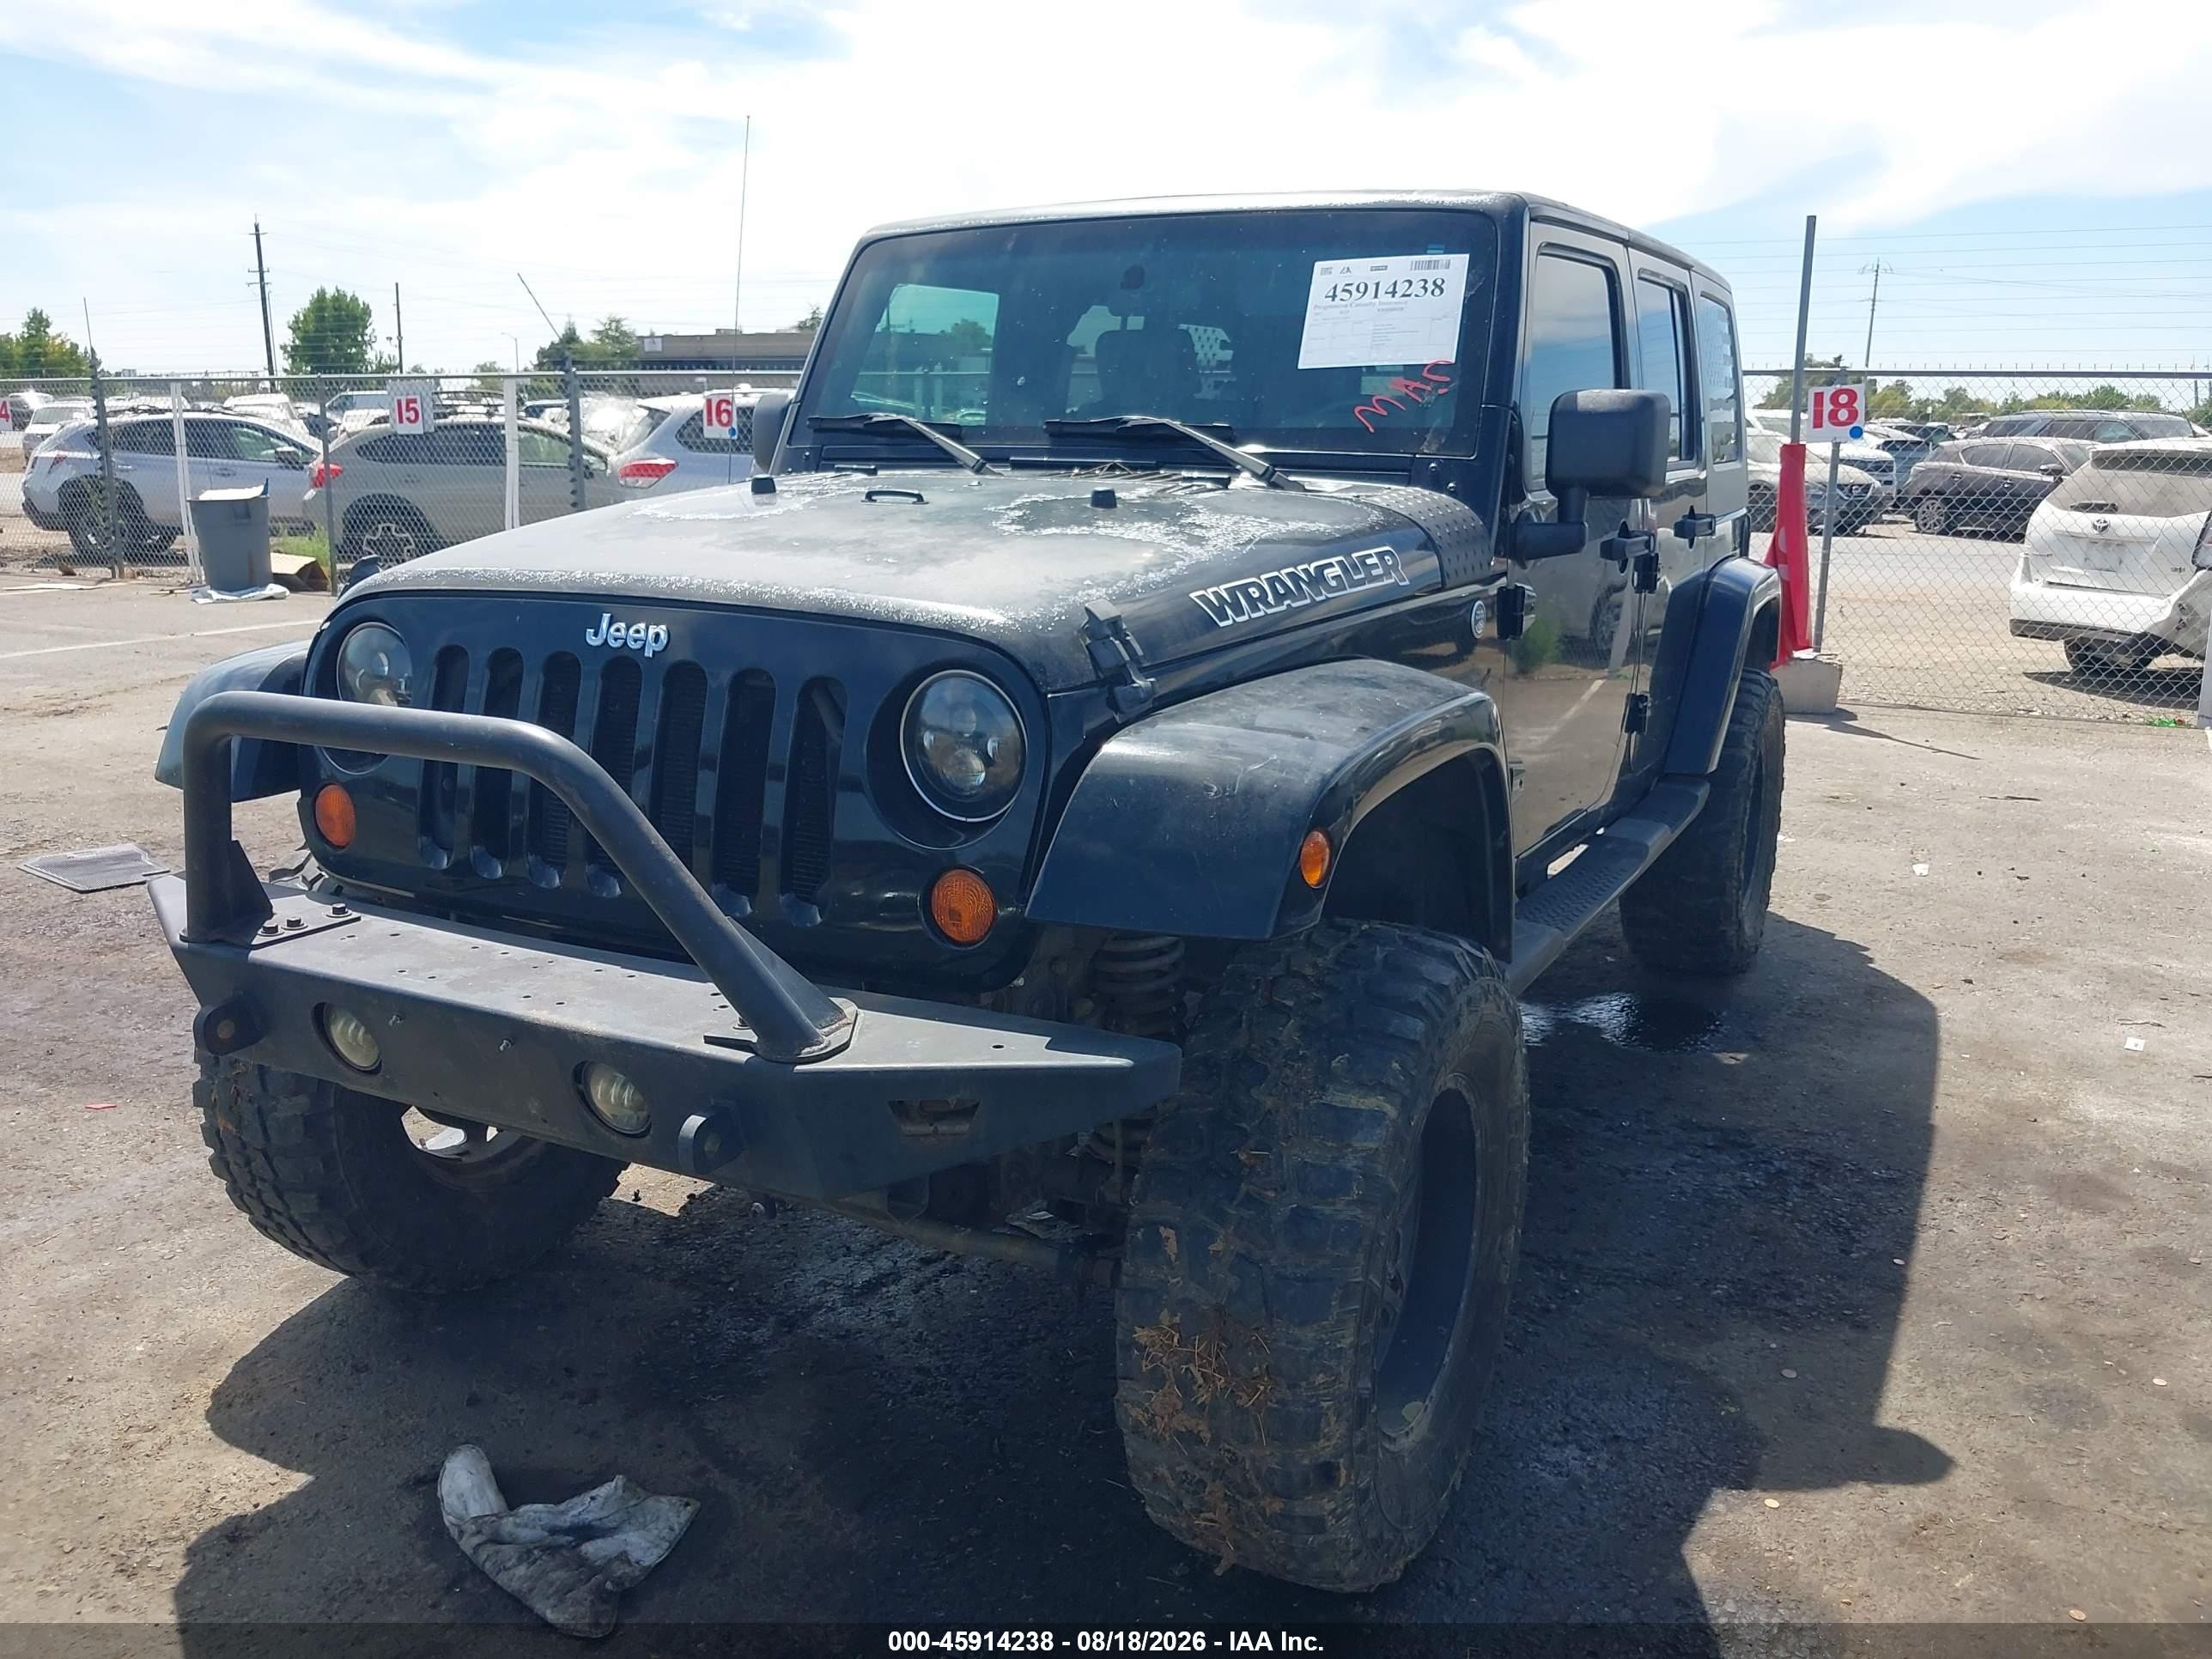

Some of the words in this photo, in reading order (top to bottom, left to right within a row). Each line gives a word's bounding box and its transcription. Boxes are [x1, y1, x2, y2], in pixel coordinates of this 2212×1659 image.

[1325, 277, 1446, 302] 45914238
[396, 398, 420, 425] 15
[706, 398, 733, 428] 16
[1812, 388, 1859, 429] 18
[1188, 545, 1411, 628] WRANGLER
[585, 612, 670, 659] Jeep
